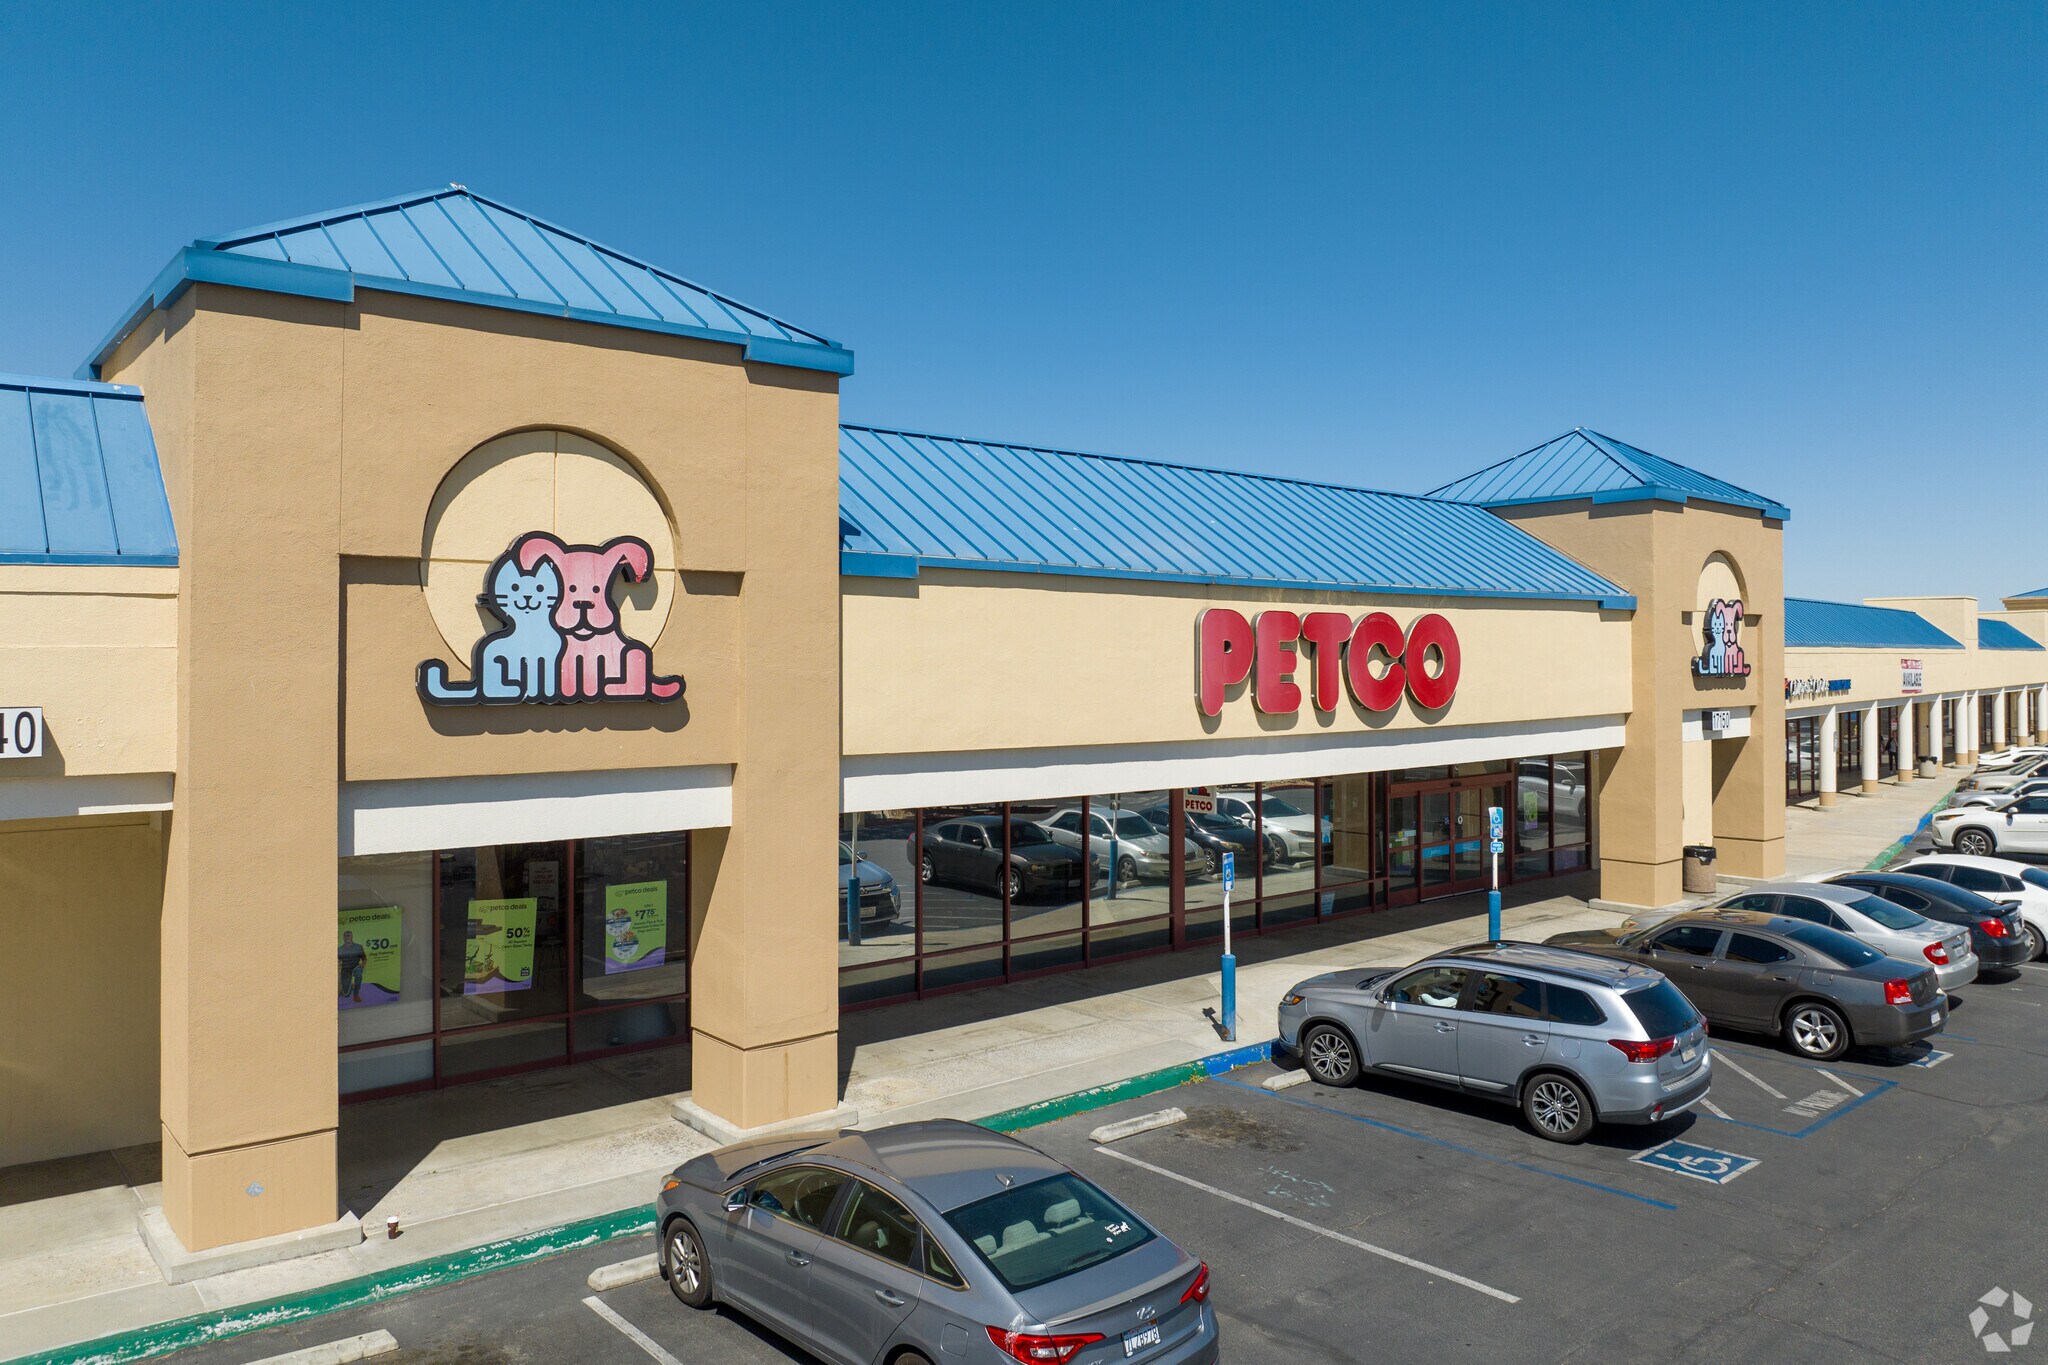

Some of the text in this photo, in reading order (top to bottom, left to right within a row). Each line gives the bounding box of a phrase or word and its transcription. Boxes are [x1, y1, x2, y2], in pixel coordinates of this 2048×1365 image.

[1199, 607, 1461, 717] PETCO
[1712, 712, 1729, 729] 17150
[1185, 799, 1213, 812] PETCO
[624, 888, 642, 896] petco
[489, 904, 510, 912] petco
[349, 912, 391, 924] petco deals
[506, 926, 530, 939] 50%
[366, 938, 390, 950] $30
[470, 1225, 566, 1255] 30 MIN PARKING
